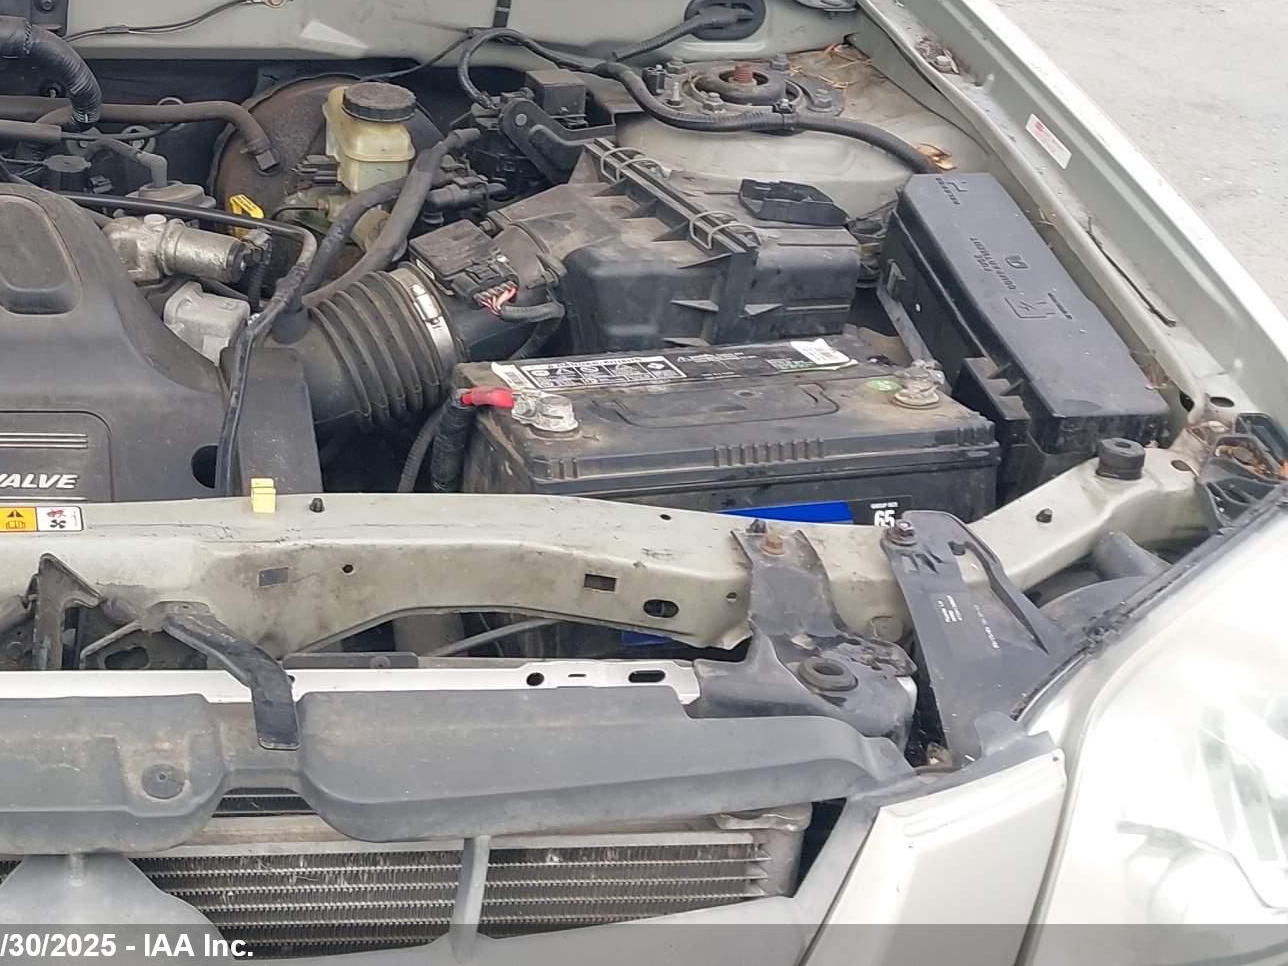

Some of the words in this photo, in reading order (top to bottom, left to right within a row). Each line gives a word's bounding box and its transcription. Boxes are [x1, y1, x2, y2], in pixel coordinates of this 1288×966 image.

[969, 237, 1017, 290] COMPARTMENT
[973, 253, 993, 272] FUSE
[873, 509, 895, 526] 65
